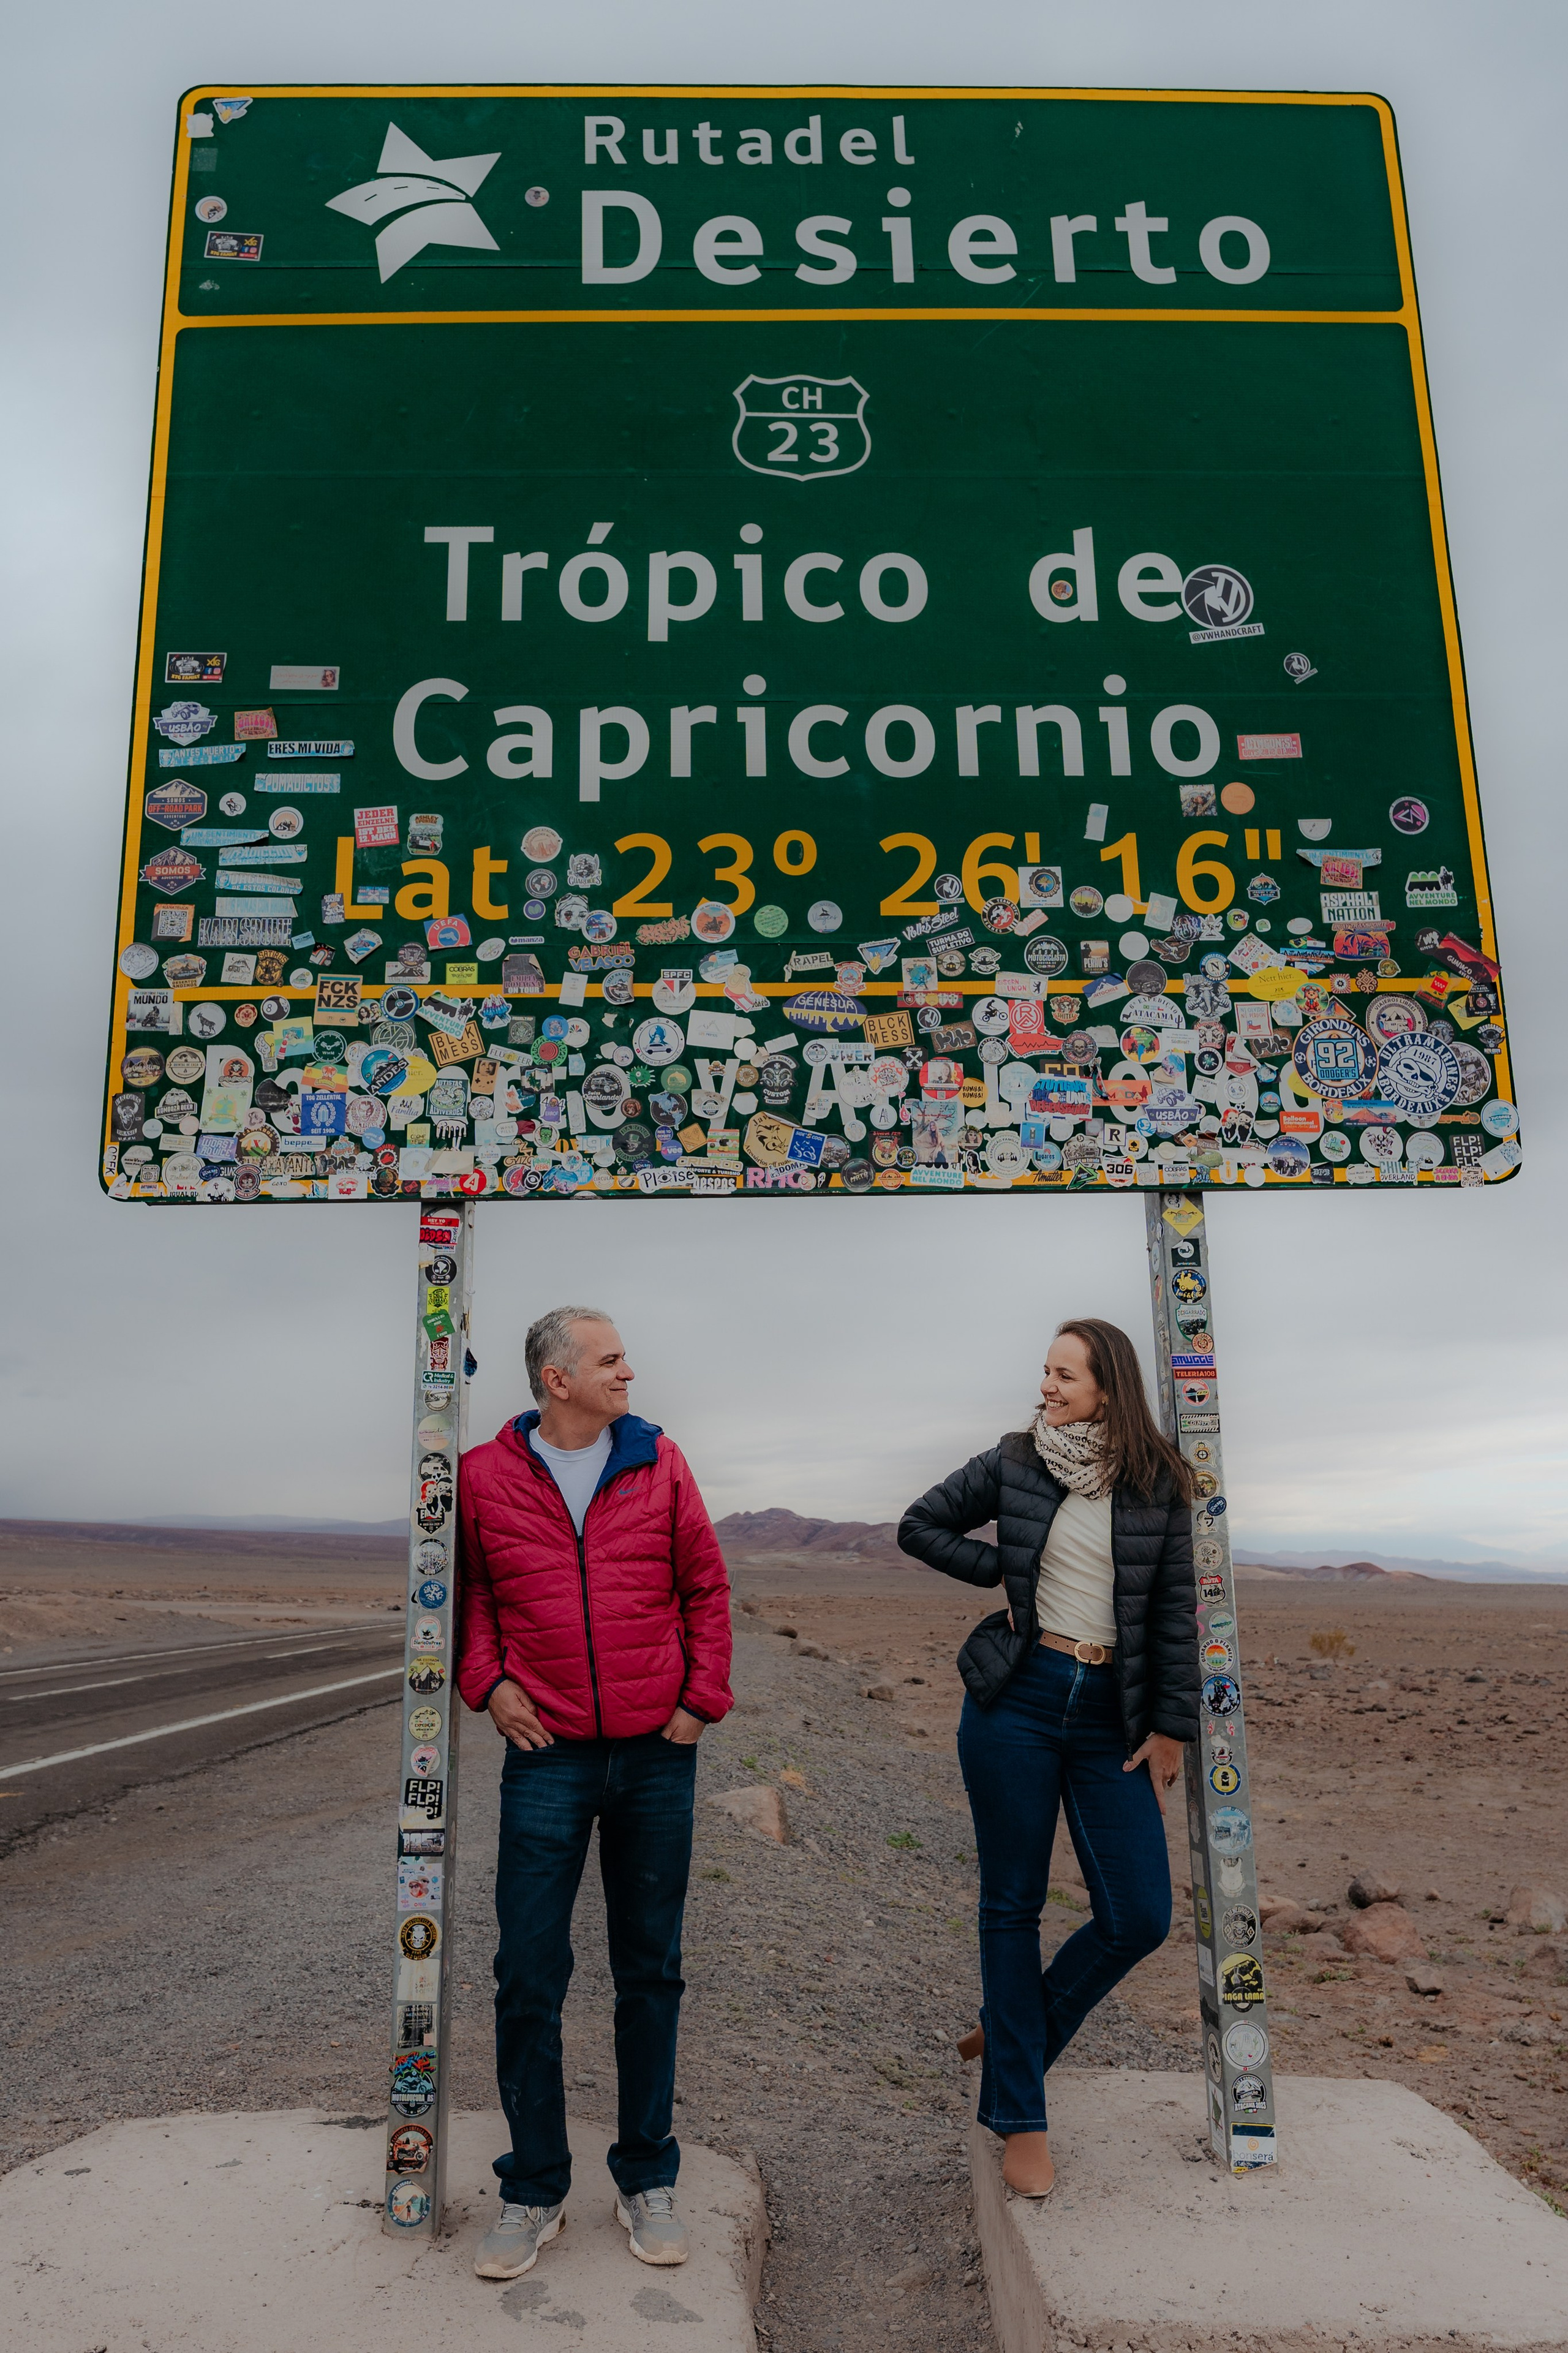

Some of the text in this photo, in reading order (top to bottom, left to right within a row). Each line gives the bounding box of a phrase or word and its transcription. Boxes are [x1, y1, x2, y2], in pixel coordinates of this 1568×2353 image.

[582, 187, 1270, 285] Desierto
[782, 387, 822, 409] CH
[768, 421, 839, 463] 23
[424, 523, 1183, 641] Trópico de
[1192, 625, 1261, 641] @VWHANDCRAFT
[168, 722, 201, 734] USBÃO
[393, 674, 1220, 801] Capricornio
[175, 746, 235, 758] ANTES MUERTO
[269, 743, 340, 754] ERES MI VIDA
[1277, 747, 1296, 756] DIJON
[265, 776, 330, 791] PUMADICTOS
[357, 809, 394, 820] JEDER
[358, 818, 394, 826] EINZELNE
[372, 832, 396, 840] MANN
[155, 867, 190, 875] SOMOS
[1323, 894, 1378, 907] ASPHALT
[920, 907, 959, 925] the Steel
[1328, 907, 1376, 921] NATION
[200, 918, 292, 946] KARLSRUHE
[433, 920, 459, 931] UEFA
[929, 934, 955, 948] TURMA
[932, 937, 973, 955] SUPLETIVO
[568, 942, 635, 958] GABRIEL
[257, 951, 289, 963] SATIROS
[569, 954, 635, 971] VELASCO
[794, 953, 832, 965] RAPEL
[1084, 957, 1108, 969] PERAU'S
[1210, 961, 1219, 975] N
[1447, 955, 1472, 975] GUANACO
[1205, 970, 1231, 982] AUSTRALIA
[1259, 975, 1276, 984] Nett
[319, 980, 358, 994] FCK
[1093, 986, 1118, 999] INTOCHILE
[134, 995, 168, 1004] MUNDO
[317, 995, 358, 1008] NZS
[797, 996, 854, 1010] GENESUR
[1139, 997, 1178, 1014] EXPEDIÇÃO
[1374, 998, 1396, 1012] VIAJEROS
[1398, 999, 1416, 1012] LIBRES
[420, 1008, 464, 1032] AVVENTURE
[1132, 1010, 1173, 1019] ATACAMA
[432, 1021, 461, 1037] MONDO
[868, 1016, 905, 1032] BLCK
[870, 1029, 909, 1043] MESS
[1299, 1019, 1370, 1048] GIRONDINS
[439, 1042, 478, 1060] MESS
[829, 1050, 872, 1061] VIVER
[1317, 1042, 1352, 1067] 92
[1412, 1049, 1438, 1065] 1987
[1381, 1033, 1460, 1093] ULTRAMARINES
[368, 1059, 407, 1093] ANDES
[1321, 1070, 1356, 1078] DODGER'S
[435, 1079, 462, 1088] AUTISTAS
[1033, 1079, 1087, 1091] STUTTGART
[1302, 1070, 1371, 1098] BORDEAUX
[763, 1087, 790, 1097] CUSTOM
[1066, 1092, 1087, 1104] UND
[1380, 1079, 1443, 1114] BORDEAUX
[391, 1106, 418, 1116] Família
[1031, 1100, 1090, 1115] REGENSBURG
[1156, 1110, 1188, 1120] USBÃO
[620, 1124, 649, 1137] BARONS
[1110, 1128, 1121, 1142] R
[201, 1138, 233, 1147] WORST
[284, 1138, 312, 1147] beppe
[1453, 1135, 1480, 1146] FLP!
[201, 1146, 232, 1157] ADVICE
[617, 1147, 647, 1161] BRABANT
[746, 1145, 767, 1167] Acessórios
[1035, 1152, 1055, 1160] Lugares
[1454, 1146, 1482, 1155] FLP!
[677, 1158, 742, 1169] CRISROD
[1106, 1164, 1133, 1174] 306
[1380, 1161, 1412, 1173] CHILE
[850, 1171, 868, 1182] MOTO
[913, 1169, 962, 1178] AVVENTURE
[929, 1177, 962, 1185] MONDO
[1200, 1641, 1213, 1663] GIRANDO
[409, 1781, 440, 1792] FLP!
[408, 1793, 439, 1805] FLP!
[1234, 2151, 1273, 2161] bonserá
